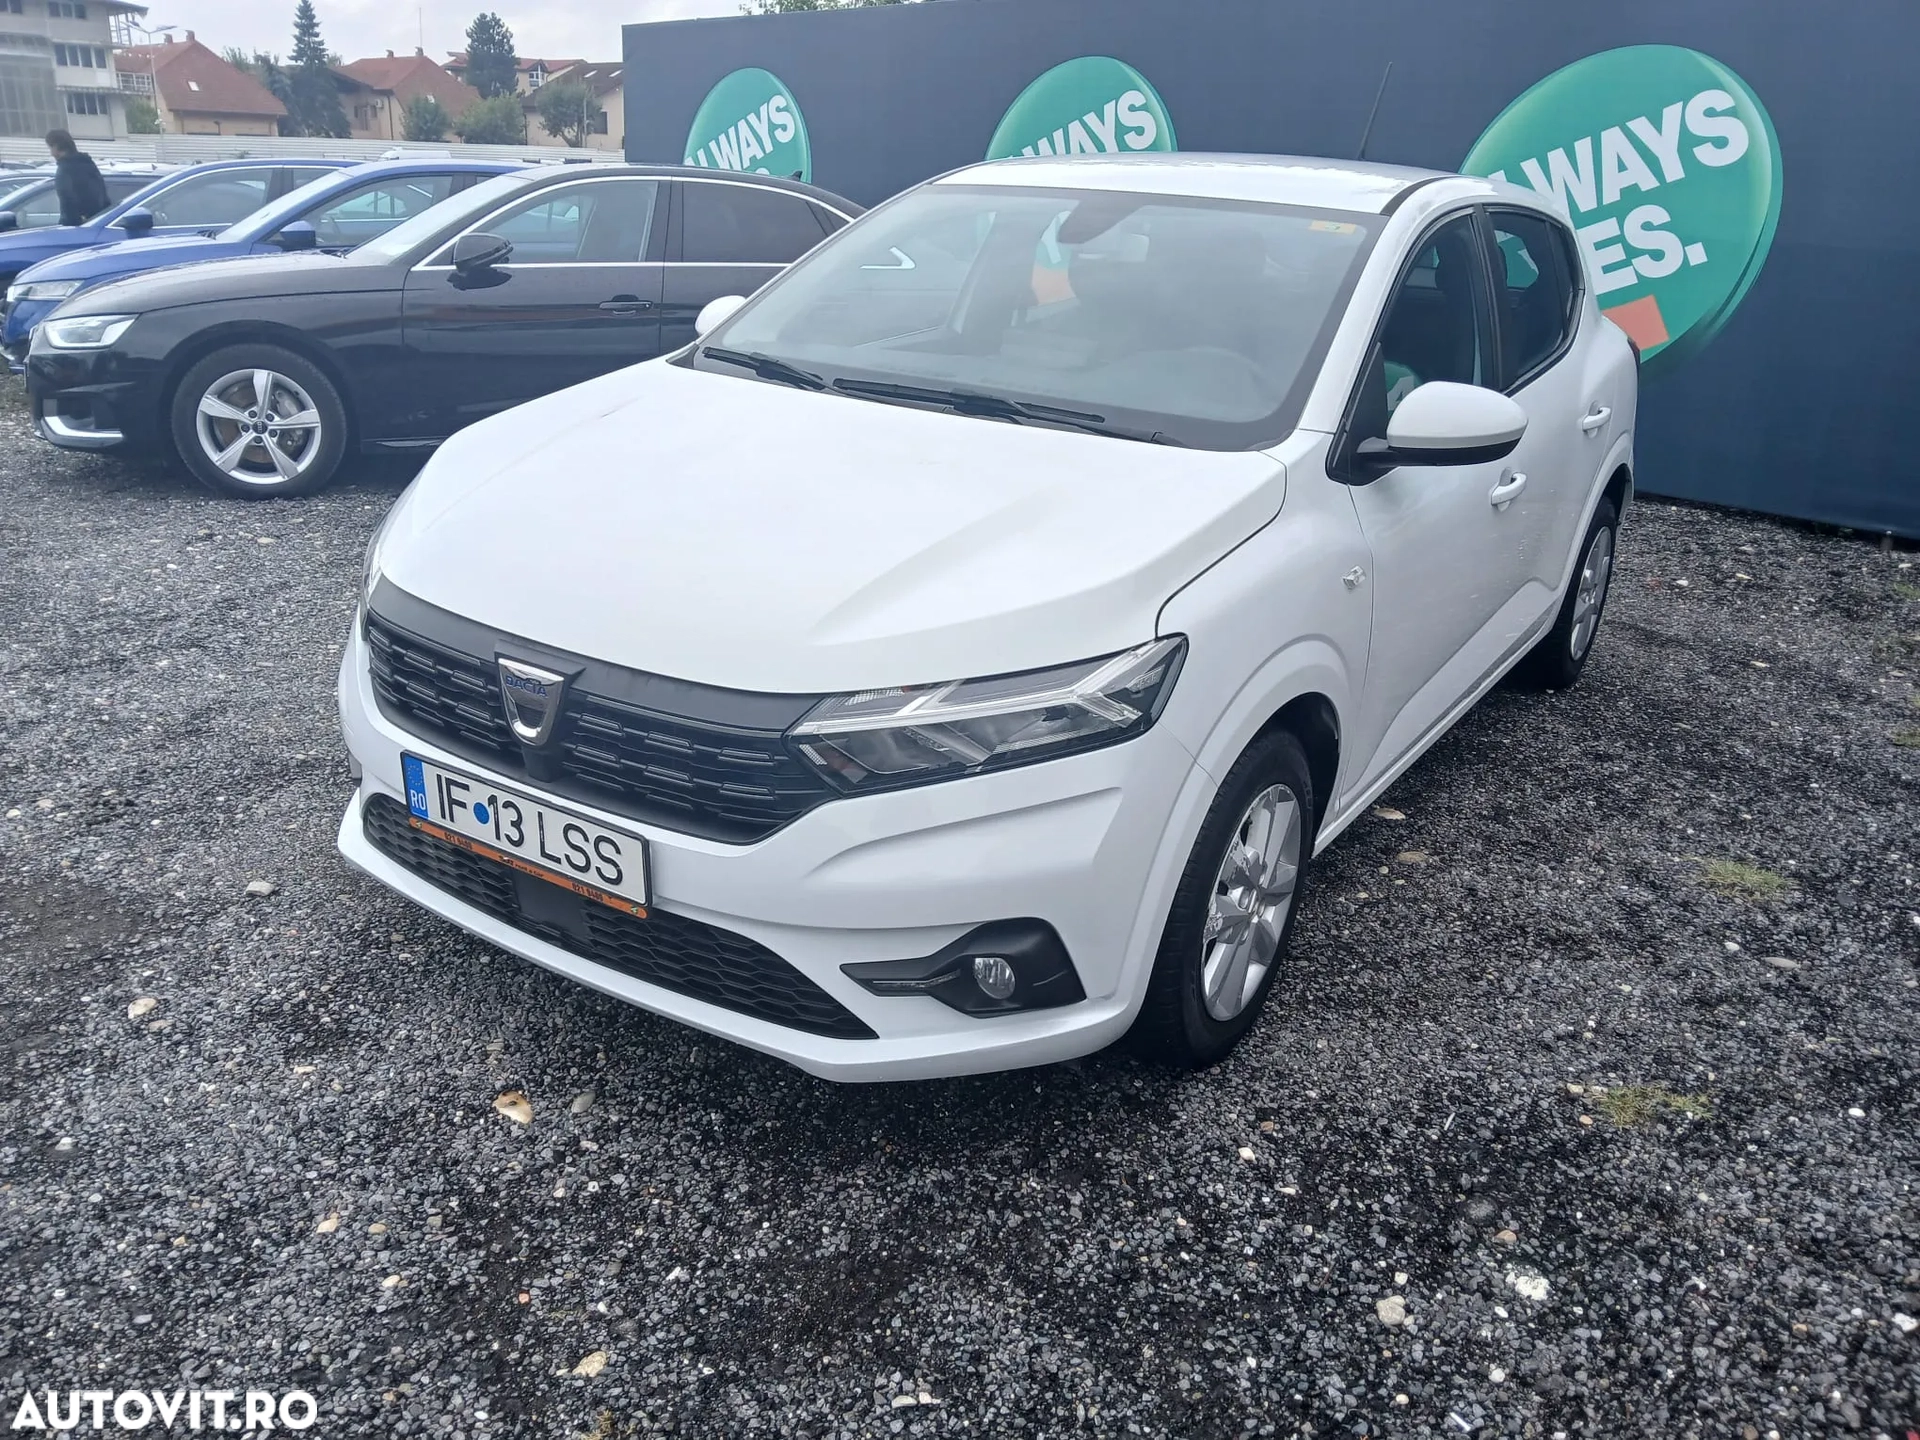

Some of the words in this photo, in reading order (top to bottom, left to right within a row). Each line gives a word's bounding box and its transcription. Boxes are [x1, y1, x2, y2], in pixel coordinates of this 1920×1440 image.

[1576, 204, 1708, 295] ES.
[506, 675, 548, 697] DACIA
[410, 789, 427, 811] RO
[436, 773, 470, 823] IF
[487, 794, 524, 847] 13
[537, 811, 623, 886] LSS
